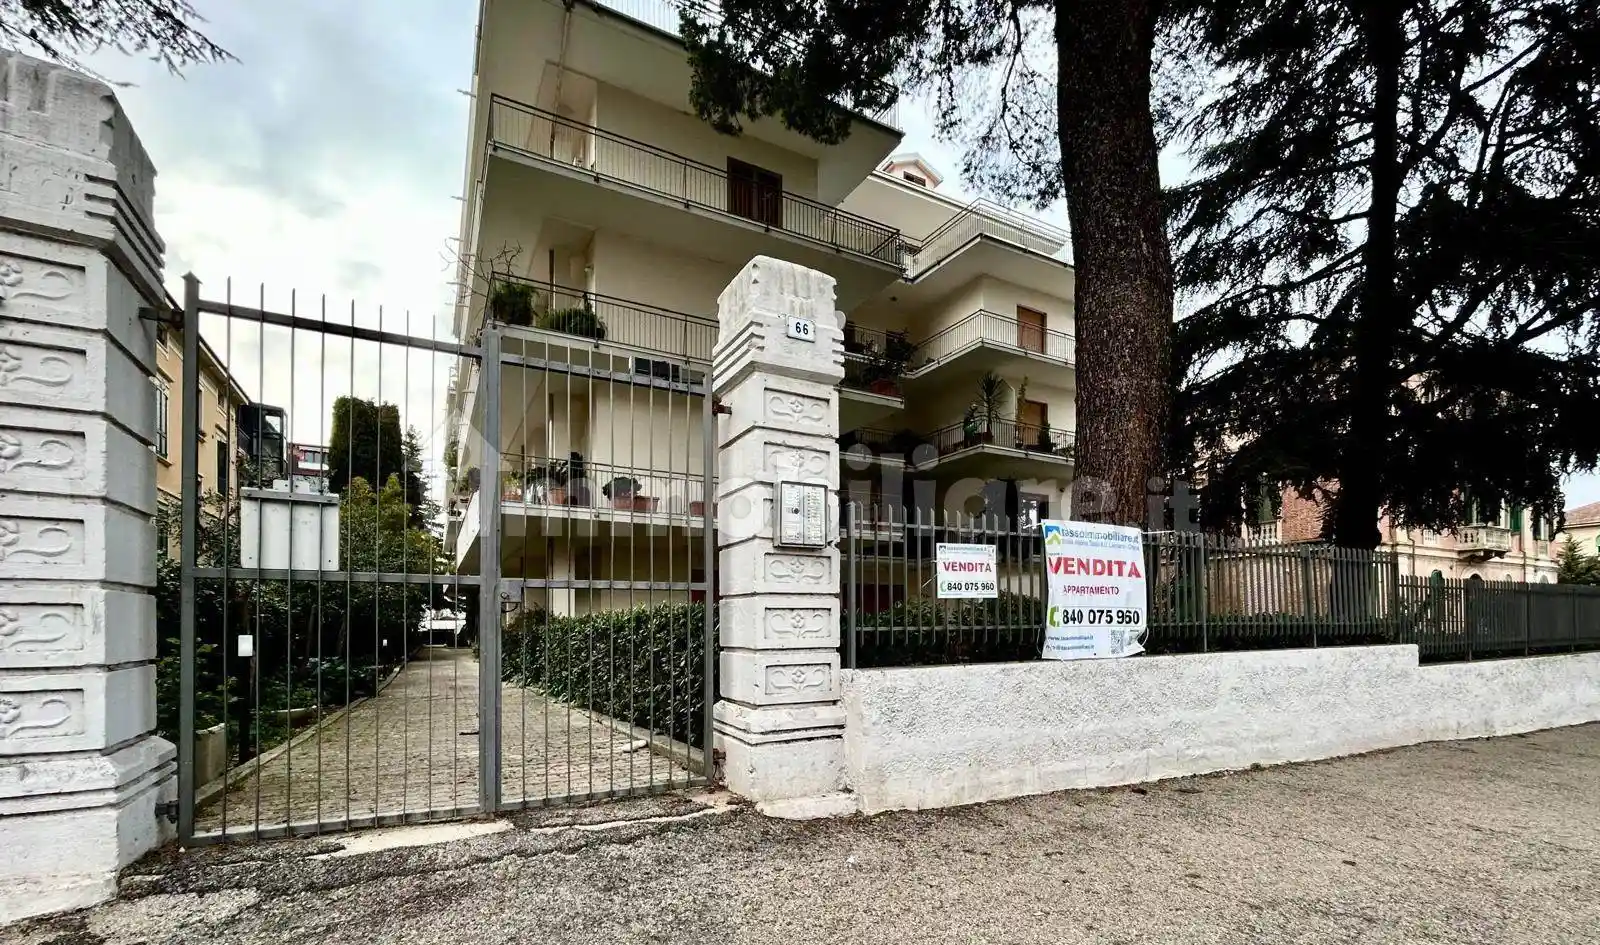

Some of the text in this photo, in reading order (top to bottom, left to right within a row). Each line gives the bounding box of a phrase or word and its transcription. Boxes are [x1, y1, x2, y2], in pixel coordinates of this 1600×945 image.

[795, 321, 809, 335] 66
[943, 561, 992, 573] VENDITA
[1048, 556, 1141, 578] VENDITA
[947, 582, 995, 591] 840 075 960
[1063, 585, 1119, 596] APPARTAMENTO
[1062, 609, 1140, 625] 840 075 960
